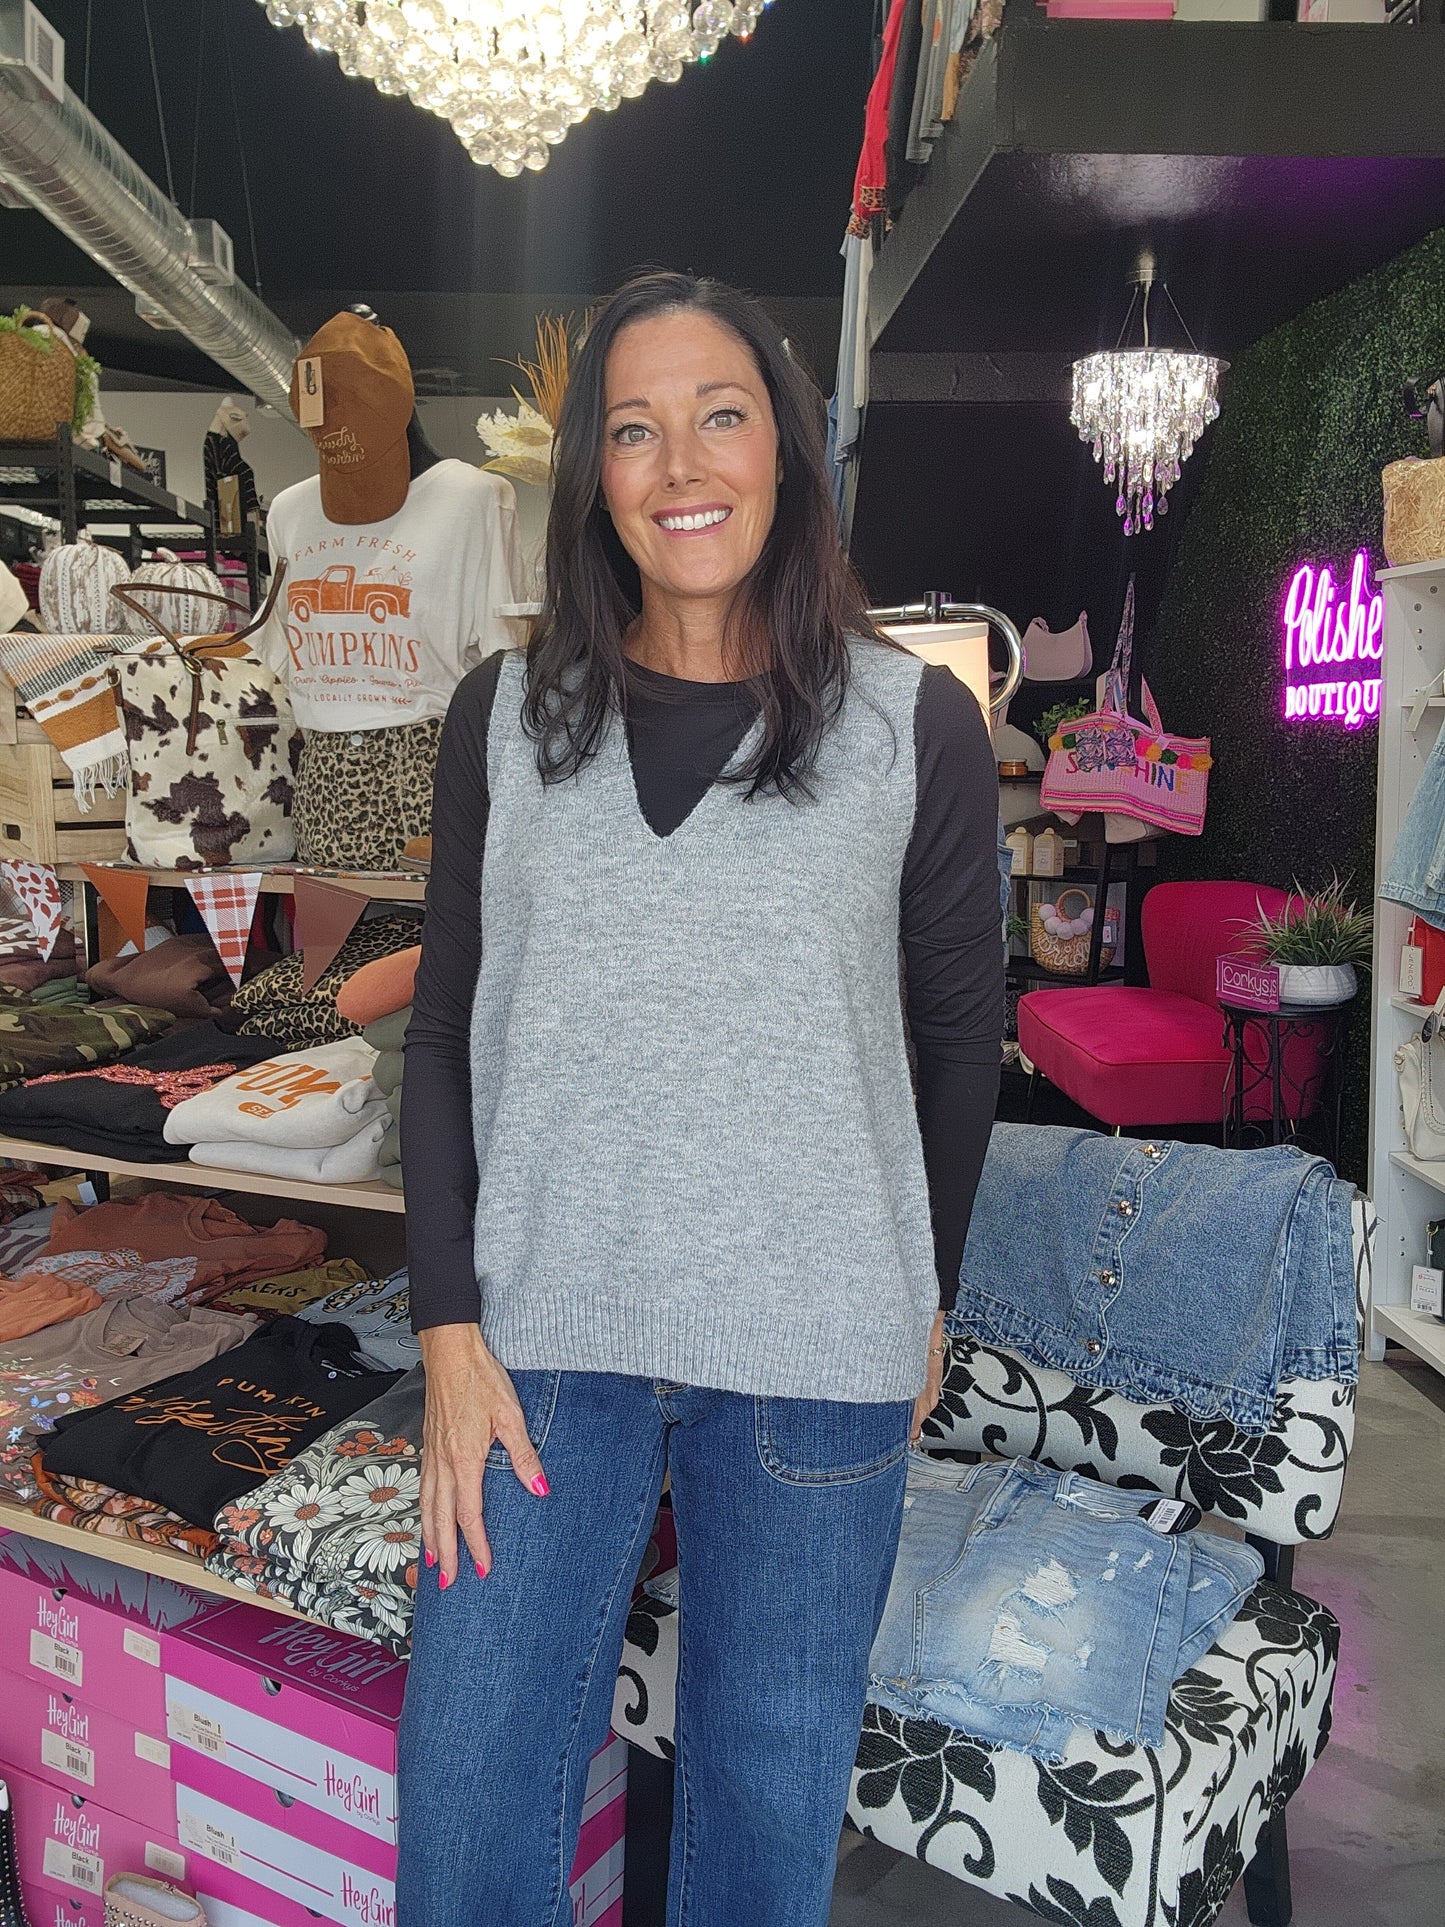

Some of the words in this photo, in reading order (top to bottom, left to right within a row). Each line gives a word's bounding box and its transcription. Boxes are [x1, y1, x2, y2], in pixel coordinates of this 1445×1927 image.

[294, 536, 345, 562] FARM
[356, 536, 417, 562] FRESH
[1066, 751, 1191, 796] SHINE
[216, 1377, 328, 1418] PUMKIN
